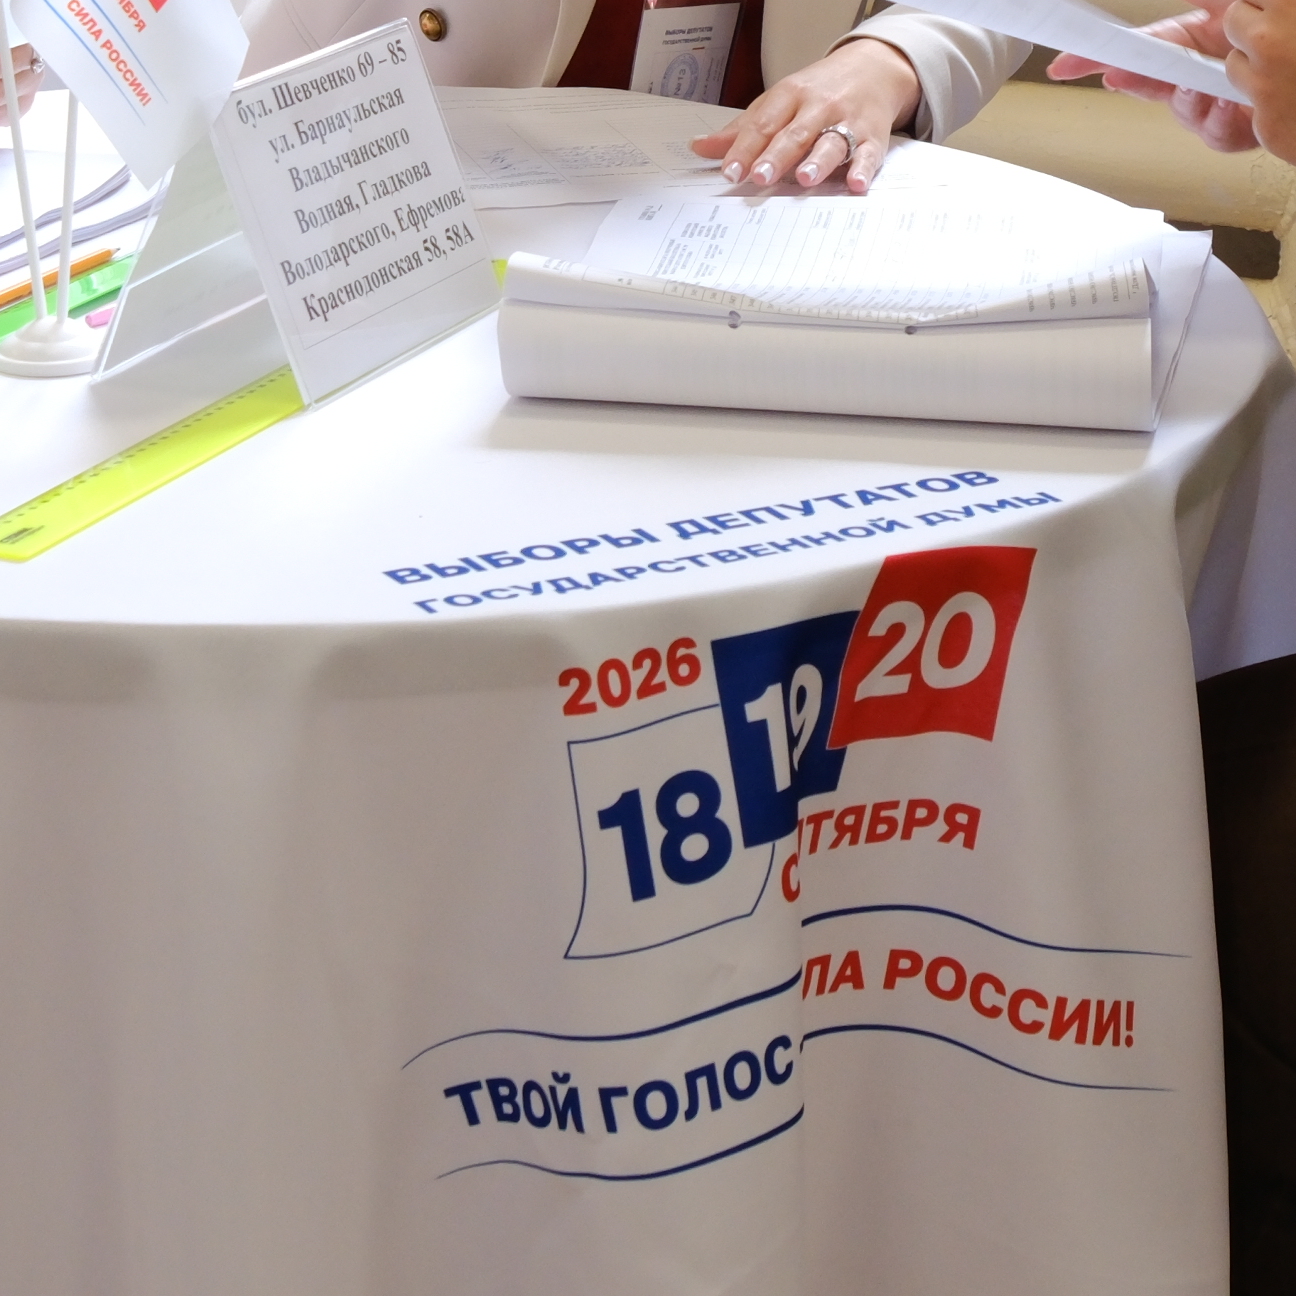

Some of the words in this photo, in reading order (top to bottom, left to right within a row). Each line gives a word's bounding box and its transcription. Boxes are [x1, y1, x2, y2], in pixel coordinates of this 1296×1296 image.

[99, 38, 153, 108] РОССИИ!
[236, 99, 273, 129] бул.
[271, 62, 356, 112] Шевченко
[356, 50, 376, 80] 69
[386, 39, 408, 66] 85
[268, 135, 296, 164] ул.
[293, 86, 406, 147] Барнаульская
[287, 126, 411, 193] Владычанского
[292, 190, 362, 236] Водная,
[357, 159, 433, 208] Гладкова
[279, 221, 398, 287] Володарского,
[301, 247, 424, 323] Краснодонская
[421, 232, 448, 265] 58,
[444, 220, 476, 255] 58А
[383, 527, 657, 587] ВЫБОРЫ
[667, 469, 1001, 543] ДЕПУТАТОВ
[412, 515, 913, 615] ГОСУДАРСТВЕННОЙ
[917, 489, 1065, 531] ДУМЫ
[557, 637, 703, 716] 2026
[595, 768, 733, 904] 18
[743, 661, 825, 794] 19
[853, 590, 997, 703] 20
[882, 948, 1137, 1049] РОССИИ!
[444, 1069, 586, 1135] ТВОЙ
[604, 1034, 794, 1135] ГОЛОС
